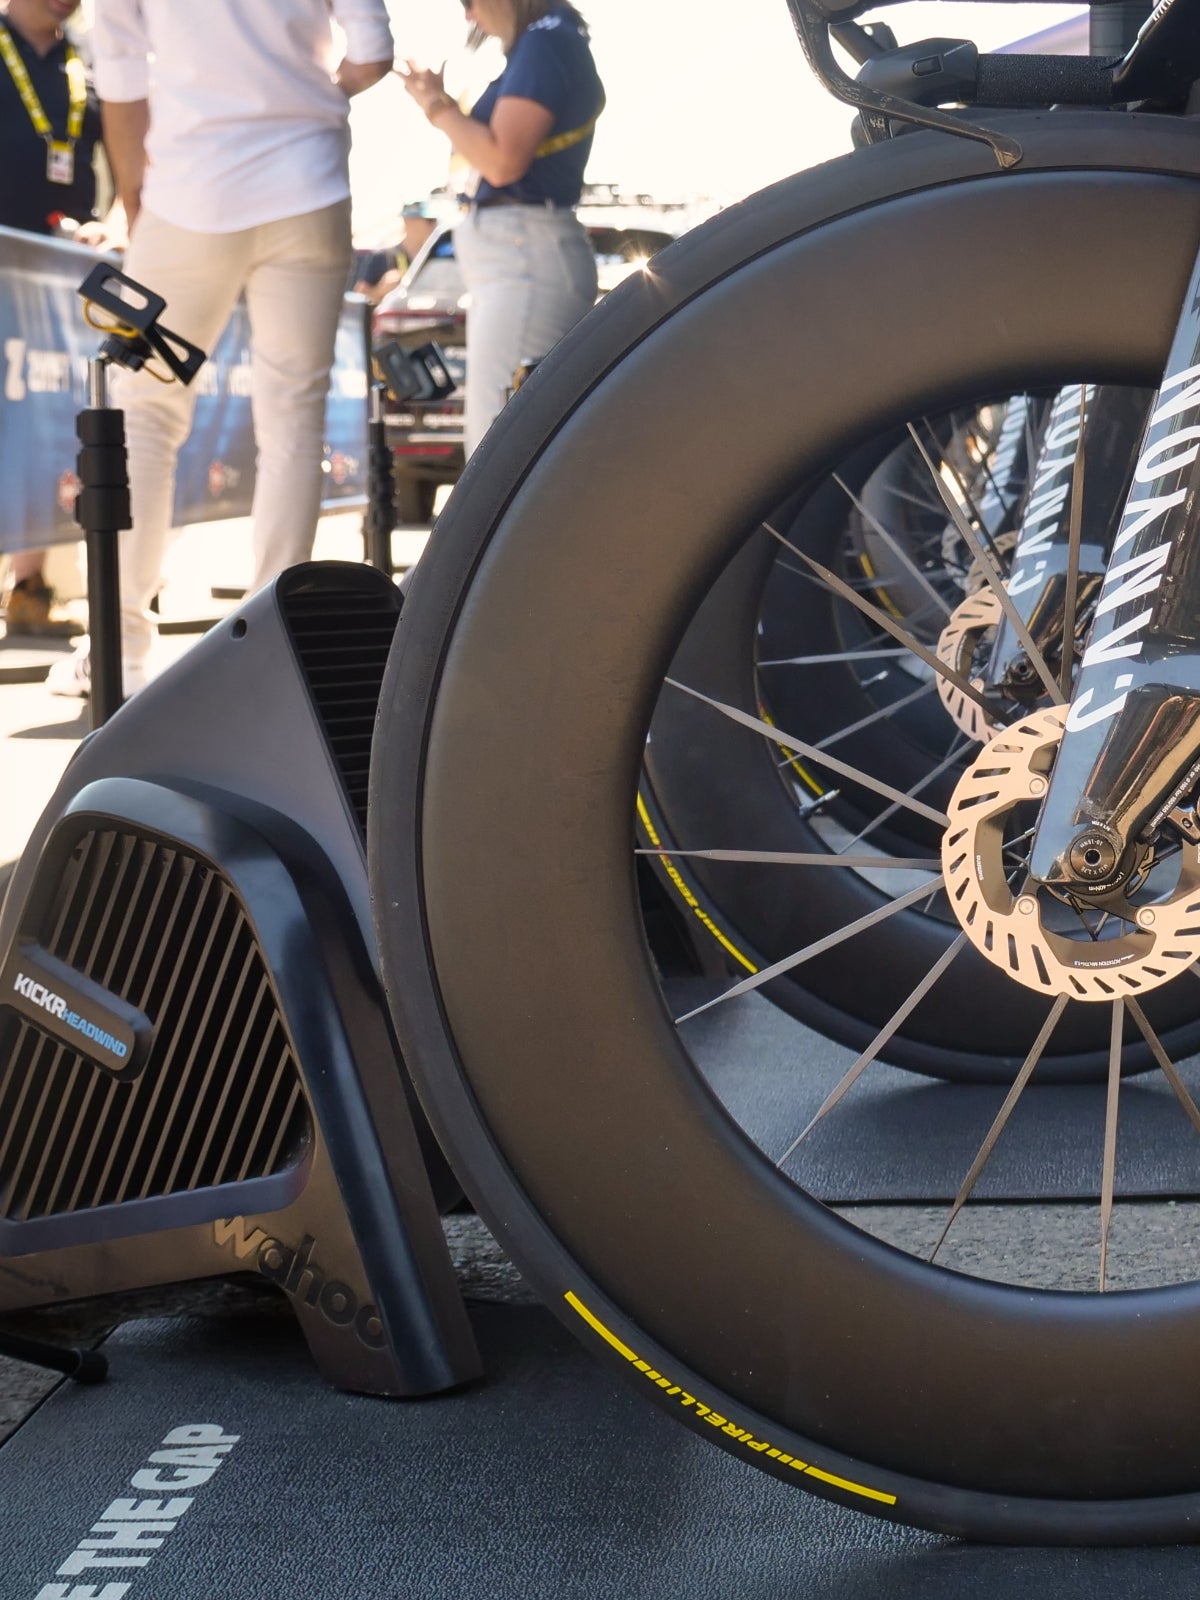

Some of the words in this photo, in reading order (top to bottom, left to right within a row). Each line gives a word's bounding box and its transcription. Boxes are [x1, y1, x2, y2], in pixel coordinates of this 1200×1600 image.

[1006, 384, 1096, 596] CANYON
[14, 973, 67, 1019] KICKR
[61, 1008, 127, 1058] HEADWIND
[214, 1215, 389, 1351] wahoo
[665, 1386, 770, 1452] PIRELLI
[55, 1497, 196, 1576] THE
[130, 1423, 241, 1491] GAP
